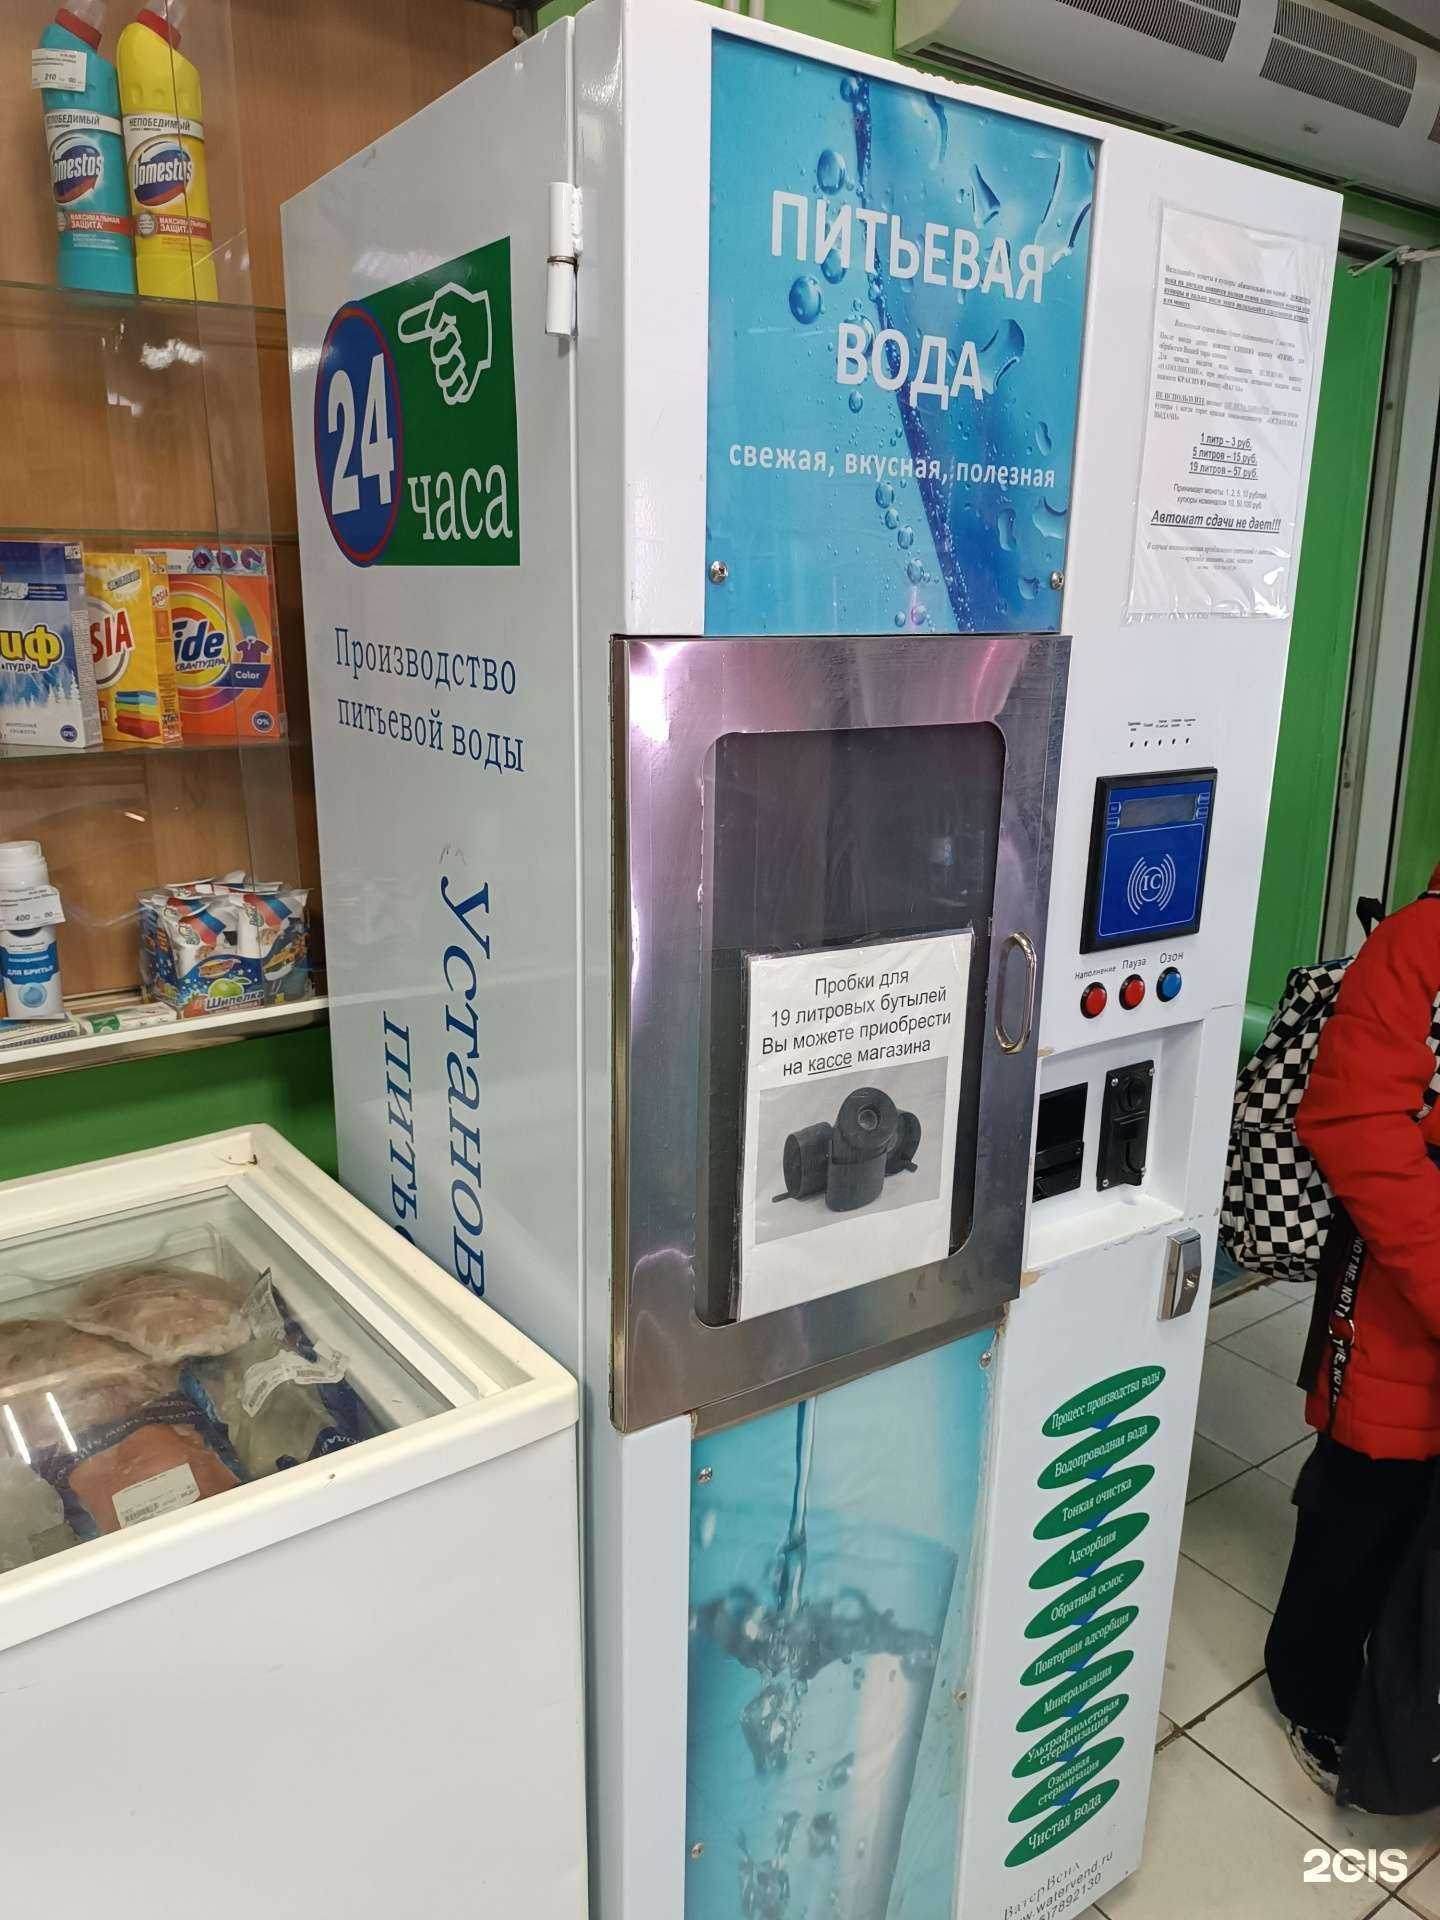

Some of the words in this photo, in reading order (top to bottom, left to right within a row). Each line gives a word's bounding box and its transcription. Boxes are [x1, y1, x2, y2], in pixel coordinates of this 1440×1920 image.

[129, 117, 191, 131] НЕПОБЕДИМЫЙ
[53, 153, 104, 183] omestos
[72, 220, 104, 230] ЗАЩИТА
[771, 190, 1046, 304] ПИТЬЕВАЯ
[836, 322, 984, 411] ВОДА
[328, 353, 395, 516] 24
[1192, 446, 1198, 456] 5
[1199, 448, 1225, 462] литров
[1233, 452, 1241, 462] 15
[1201, 432, 1205, 443] 1
[1206, 435, 1223, 446] литр
[1232, 437, 1236, 446] 3
[728, 443, 836, 477] свежая,
[845, 452, 948, 486] вкусная,
[956, 460, 1056, 489] полезная
[1190, 461, 1198, 471] 19
[1200, 464, 1226, 477] литров
[1234, 466, 1241, 476] 57
[408, 464, 513, 541] часа
[1151, 510, 1204, 524] Автомат
[1205, 513, 1234, 528] сдачи
[1236, 518, 1247, 528] не
[1248, 516, 1282, 531] дает!!!
[0, 624, 63, 669] иф
[335, 627, 516, 694] Производство
[235, 669, 261, 681] Color
[338, 698, 444, 751] питьевой
[452, 724, 524, 775] воды
[1142, 873, 1162, 891] IC
[1075, 965, 1117, 980] Наполнение
[1122, 957, 1147, 971] Пауза
[1159, 952, 1184, 964] Озон
[206, 991, 265, 1010] Шипелка
[815, 973, 875, 998] Пробки
[878, 970, 909, 989] для
[771, 1009, 791, 1028] 19
[795, 999, 875, 1024] литровых
[880, 986, 947, 1013] бутылей
[762, 1037, 788, 1055] Вы
[793, 1027, 855, 1051] можете
[859, 1012, 951, 1039] приобрести
[783, 1060, 803, 1077] на
[808, 1052, 853, 1073] кассе
[857, 1039, 931, 1063] магазина
[1052, 1405, 1086, 1430] Процесс
[1086, 1380, 1140, 1414] производства
[1141, 1371, 1160, 1389] воды
[1055, 1435, 1125, 1478] Водопроводная
[1127, 1424, 1148, 1441] вода
[1063, 1497, 1094, 1522] Тонкая
[1095, 1478, 1132, 1504] очистка
[1068, 1530, 1117, 1565] Адсорбция
[1050, 1587, 1096, 1622] Обратный
[1098, 1573, 1124, 1595] осмос
[1034, 1641, 1083, 1677] Повторная
[1084, 1612, 1130, 1647] адсорбция
[1043, 1665, 1112, 1715] Минерализация
[1028, 1698, 1120, 1763] Ультрафиолетовая
[1039, 1716, 1110, 1766] стерилизация
[1038, 1759, 1100, 1806] стерилизация
[1047, 1755, 1090, 1789] Озоновая
[1028, 1814, 1072, 1850] Чистая
[1074, 1793, 1101, 1820] вода
